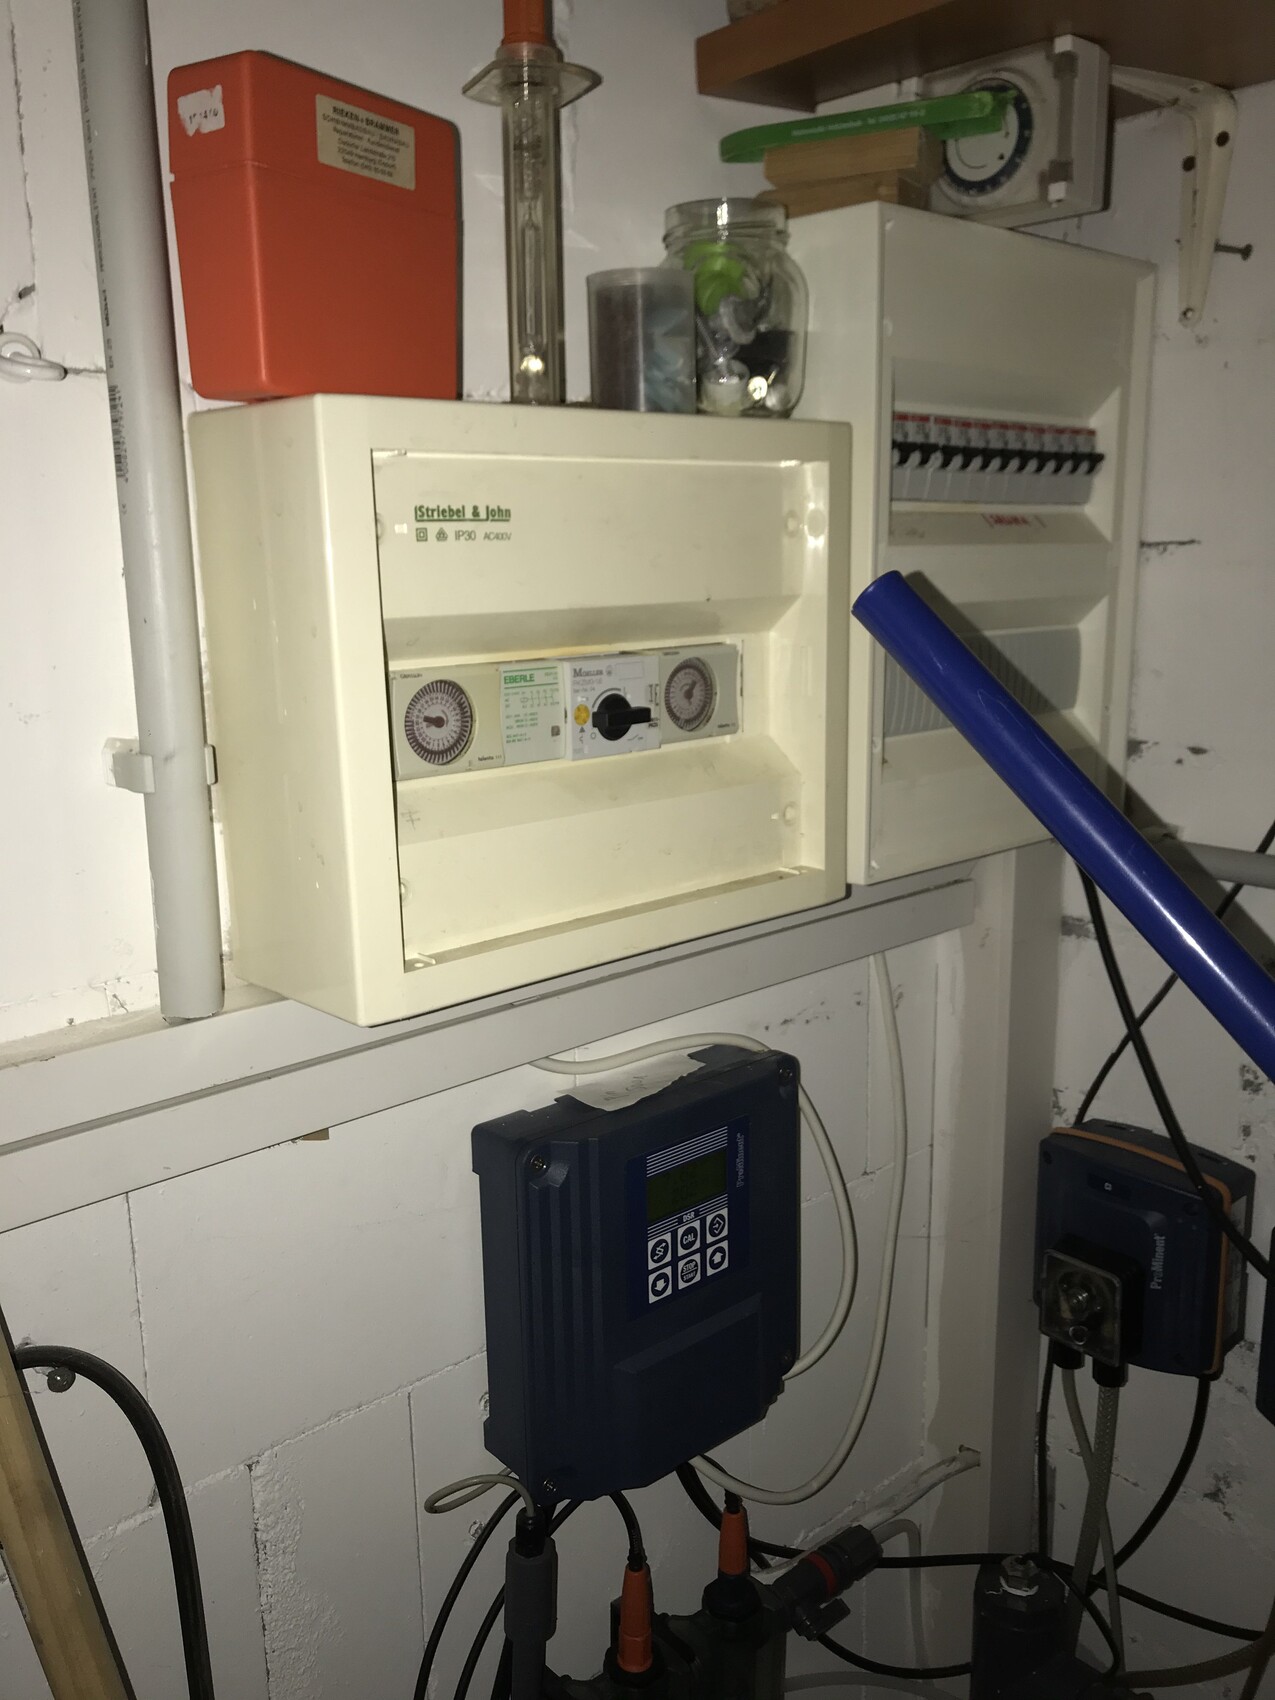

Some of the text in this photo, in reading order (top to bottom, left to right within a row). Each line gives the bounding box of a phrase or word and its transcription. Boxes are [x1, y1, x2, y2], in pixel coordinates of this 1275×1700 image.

[417, 504, 512, 521] Striebel & John
[454, 529, 477, 541] IP30
[503, 673, 535, 685] EBERLE
[682, 1211, 695, 1222] DSR
[682, 1232, 696, 1244] CAL
[682, 1260, 696, 1273] STOP
[1149, 1233, 1166, 1290] ProMinent
